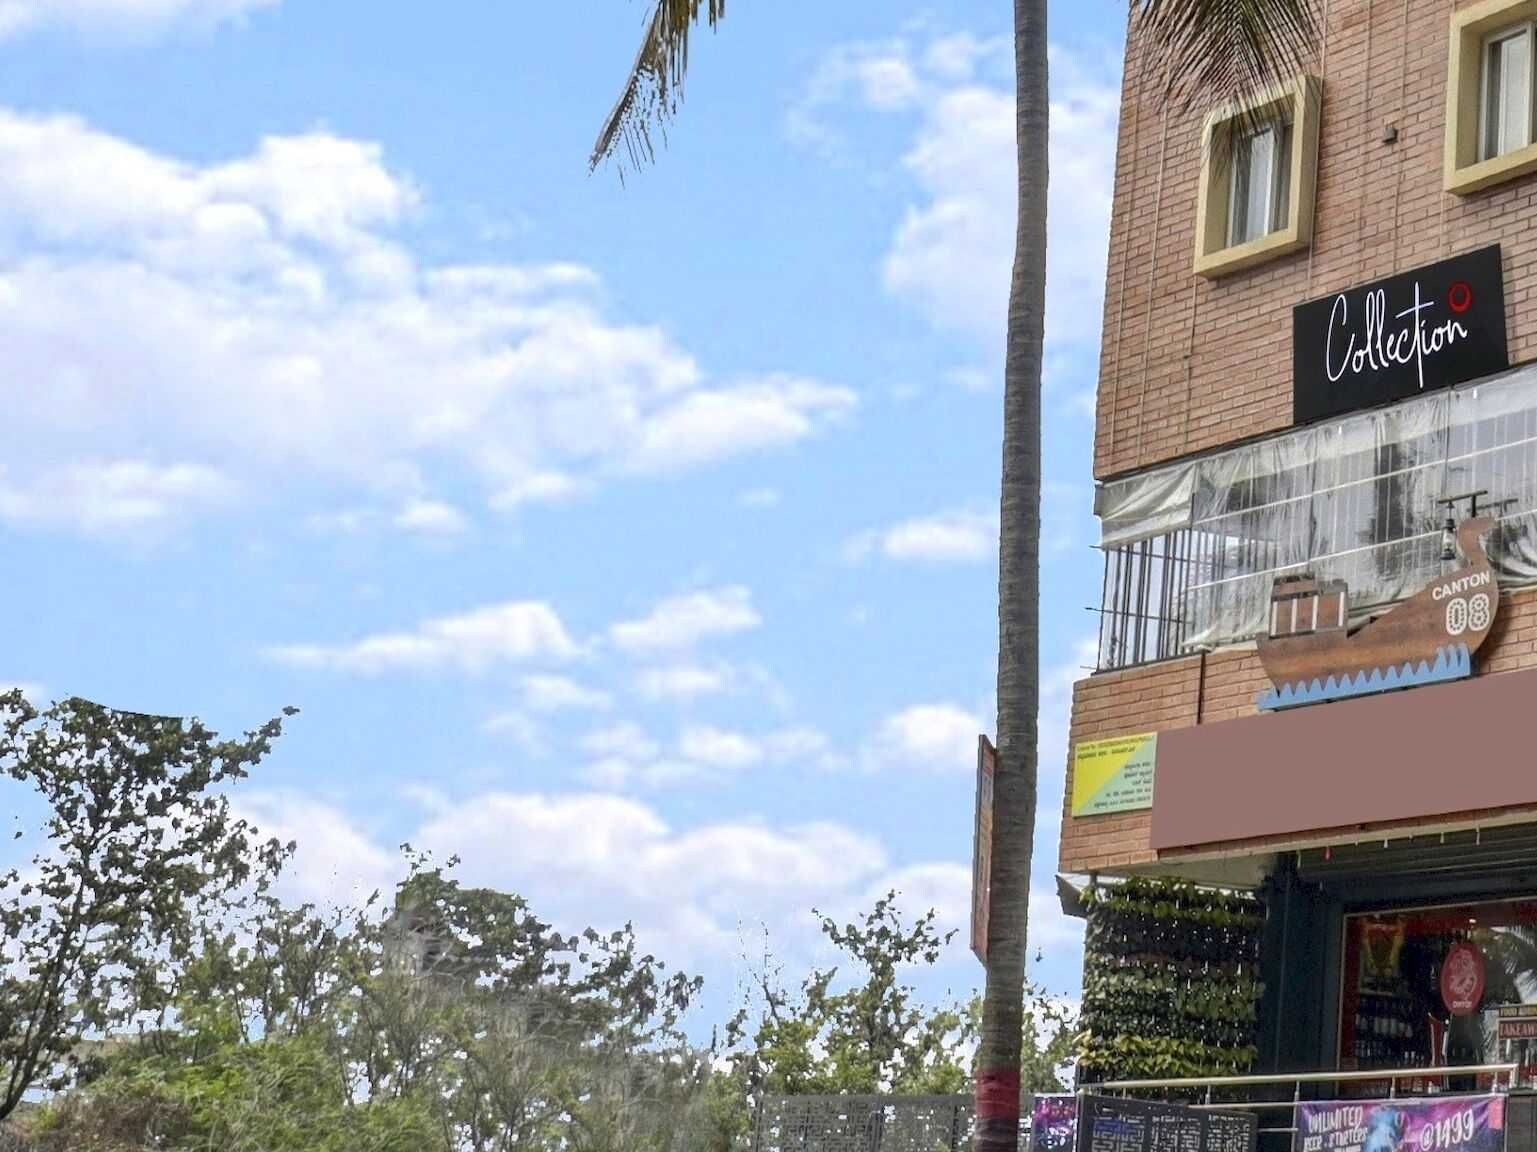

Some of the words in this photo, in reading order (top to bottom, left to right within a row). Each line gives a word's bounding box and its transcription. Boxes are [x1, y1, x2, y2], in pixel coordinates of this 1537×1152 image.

[1326, 281, 1467, 388] Collection
[1432, 571, 1490, 600] CANTON
[1446, 593, 1490, 635] 08
[1309, 1106, 1363, 1134] UNLIMITED
[1420, 1109, 1474, 1151] @1499
